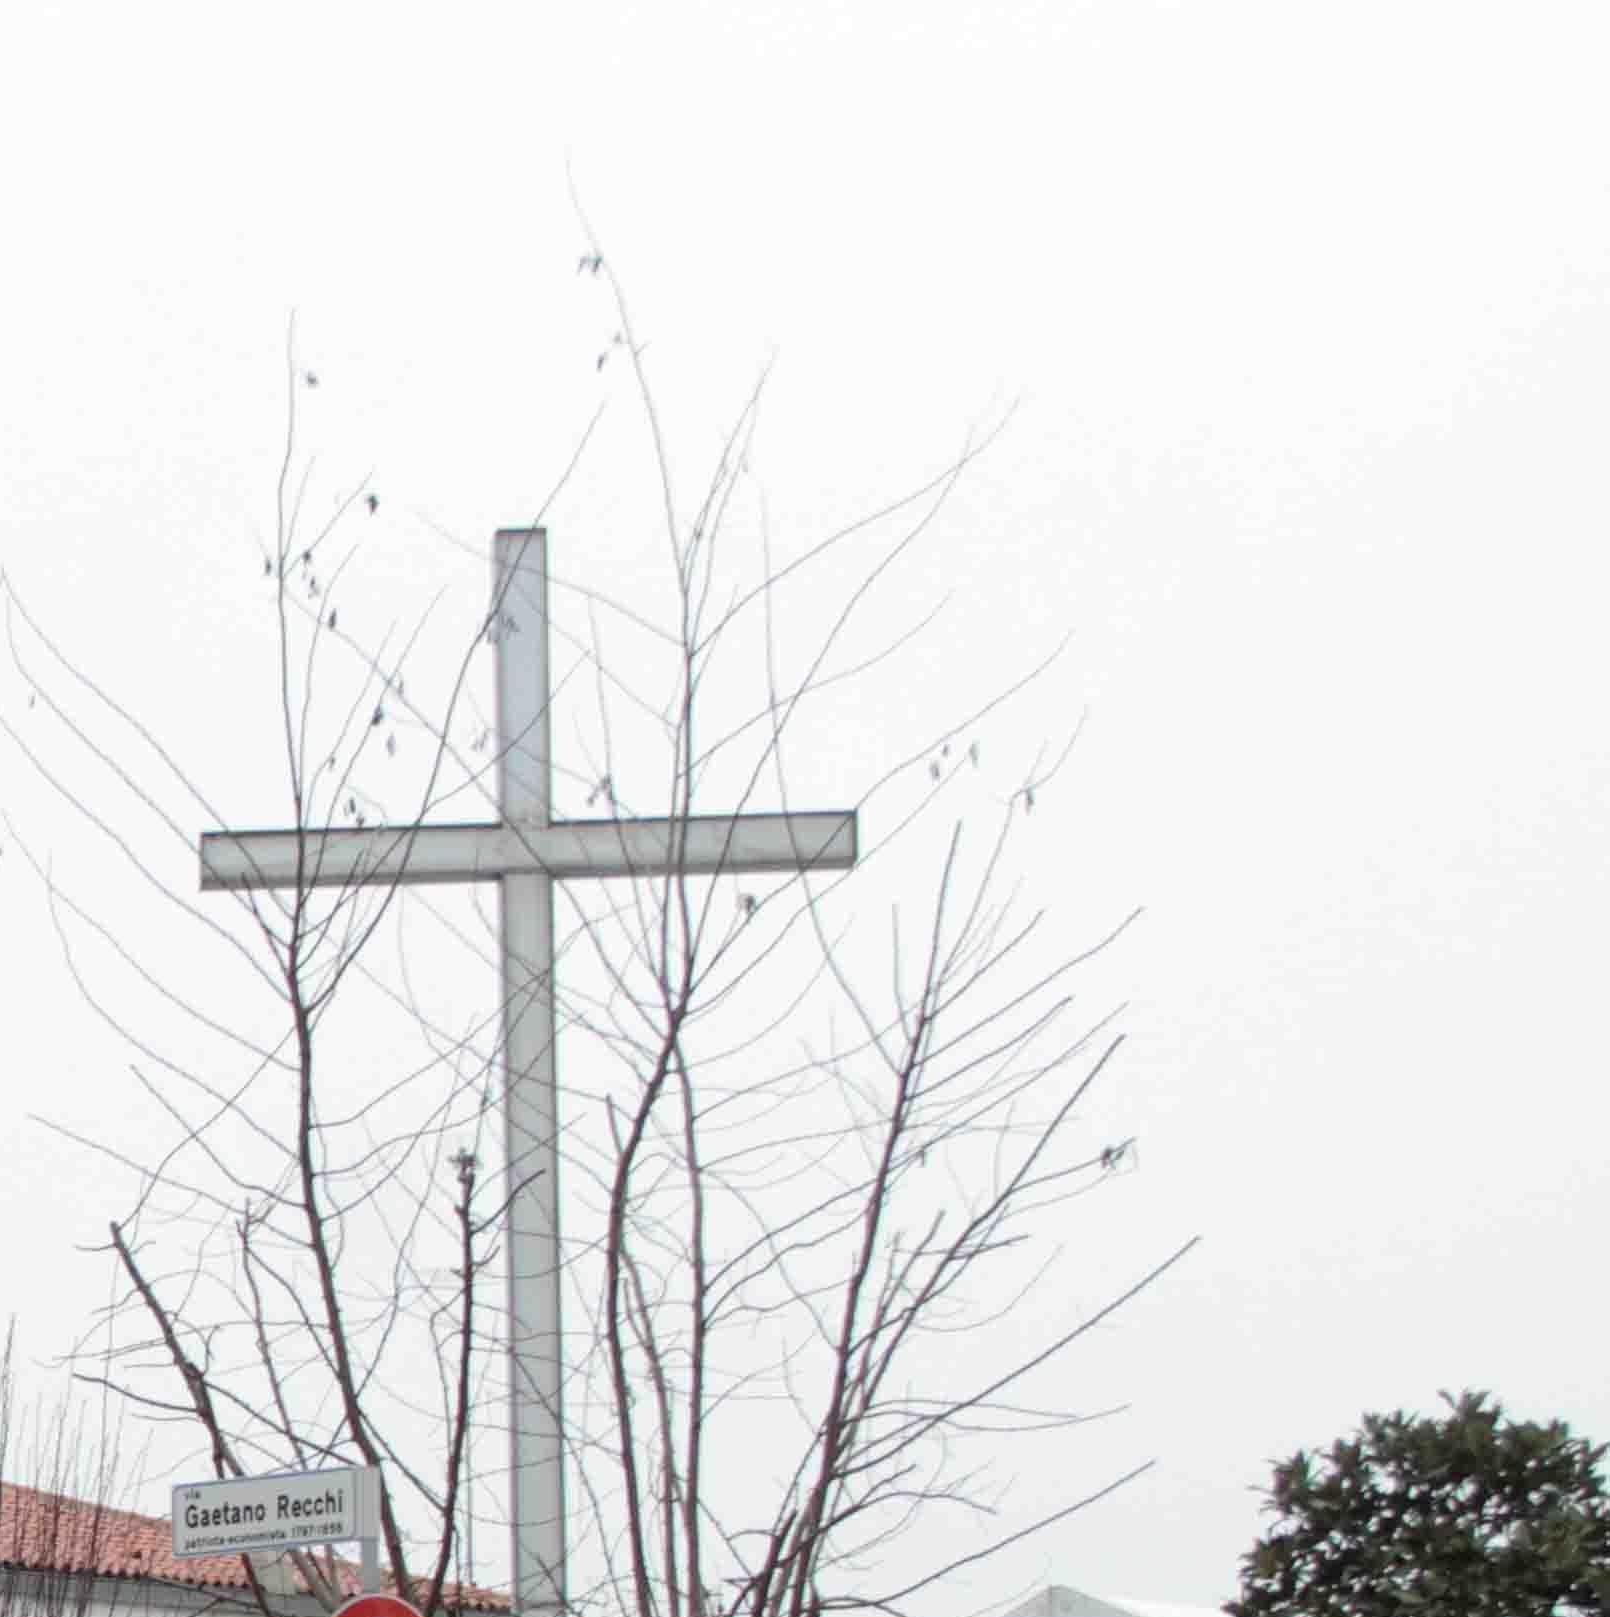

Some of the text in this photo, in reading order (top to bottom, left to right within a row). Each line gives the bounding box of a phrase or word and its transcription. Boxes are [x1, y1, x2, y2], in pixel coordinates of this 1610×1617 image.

[184, 1488, 201, 1501] via
[185, 1489, 343, 1528] Gaetano Recchi
